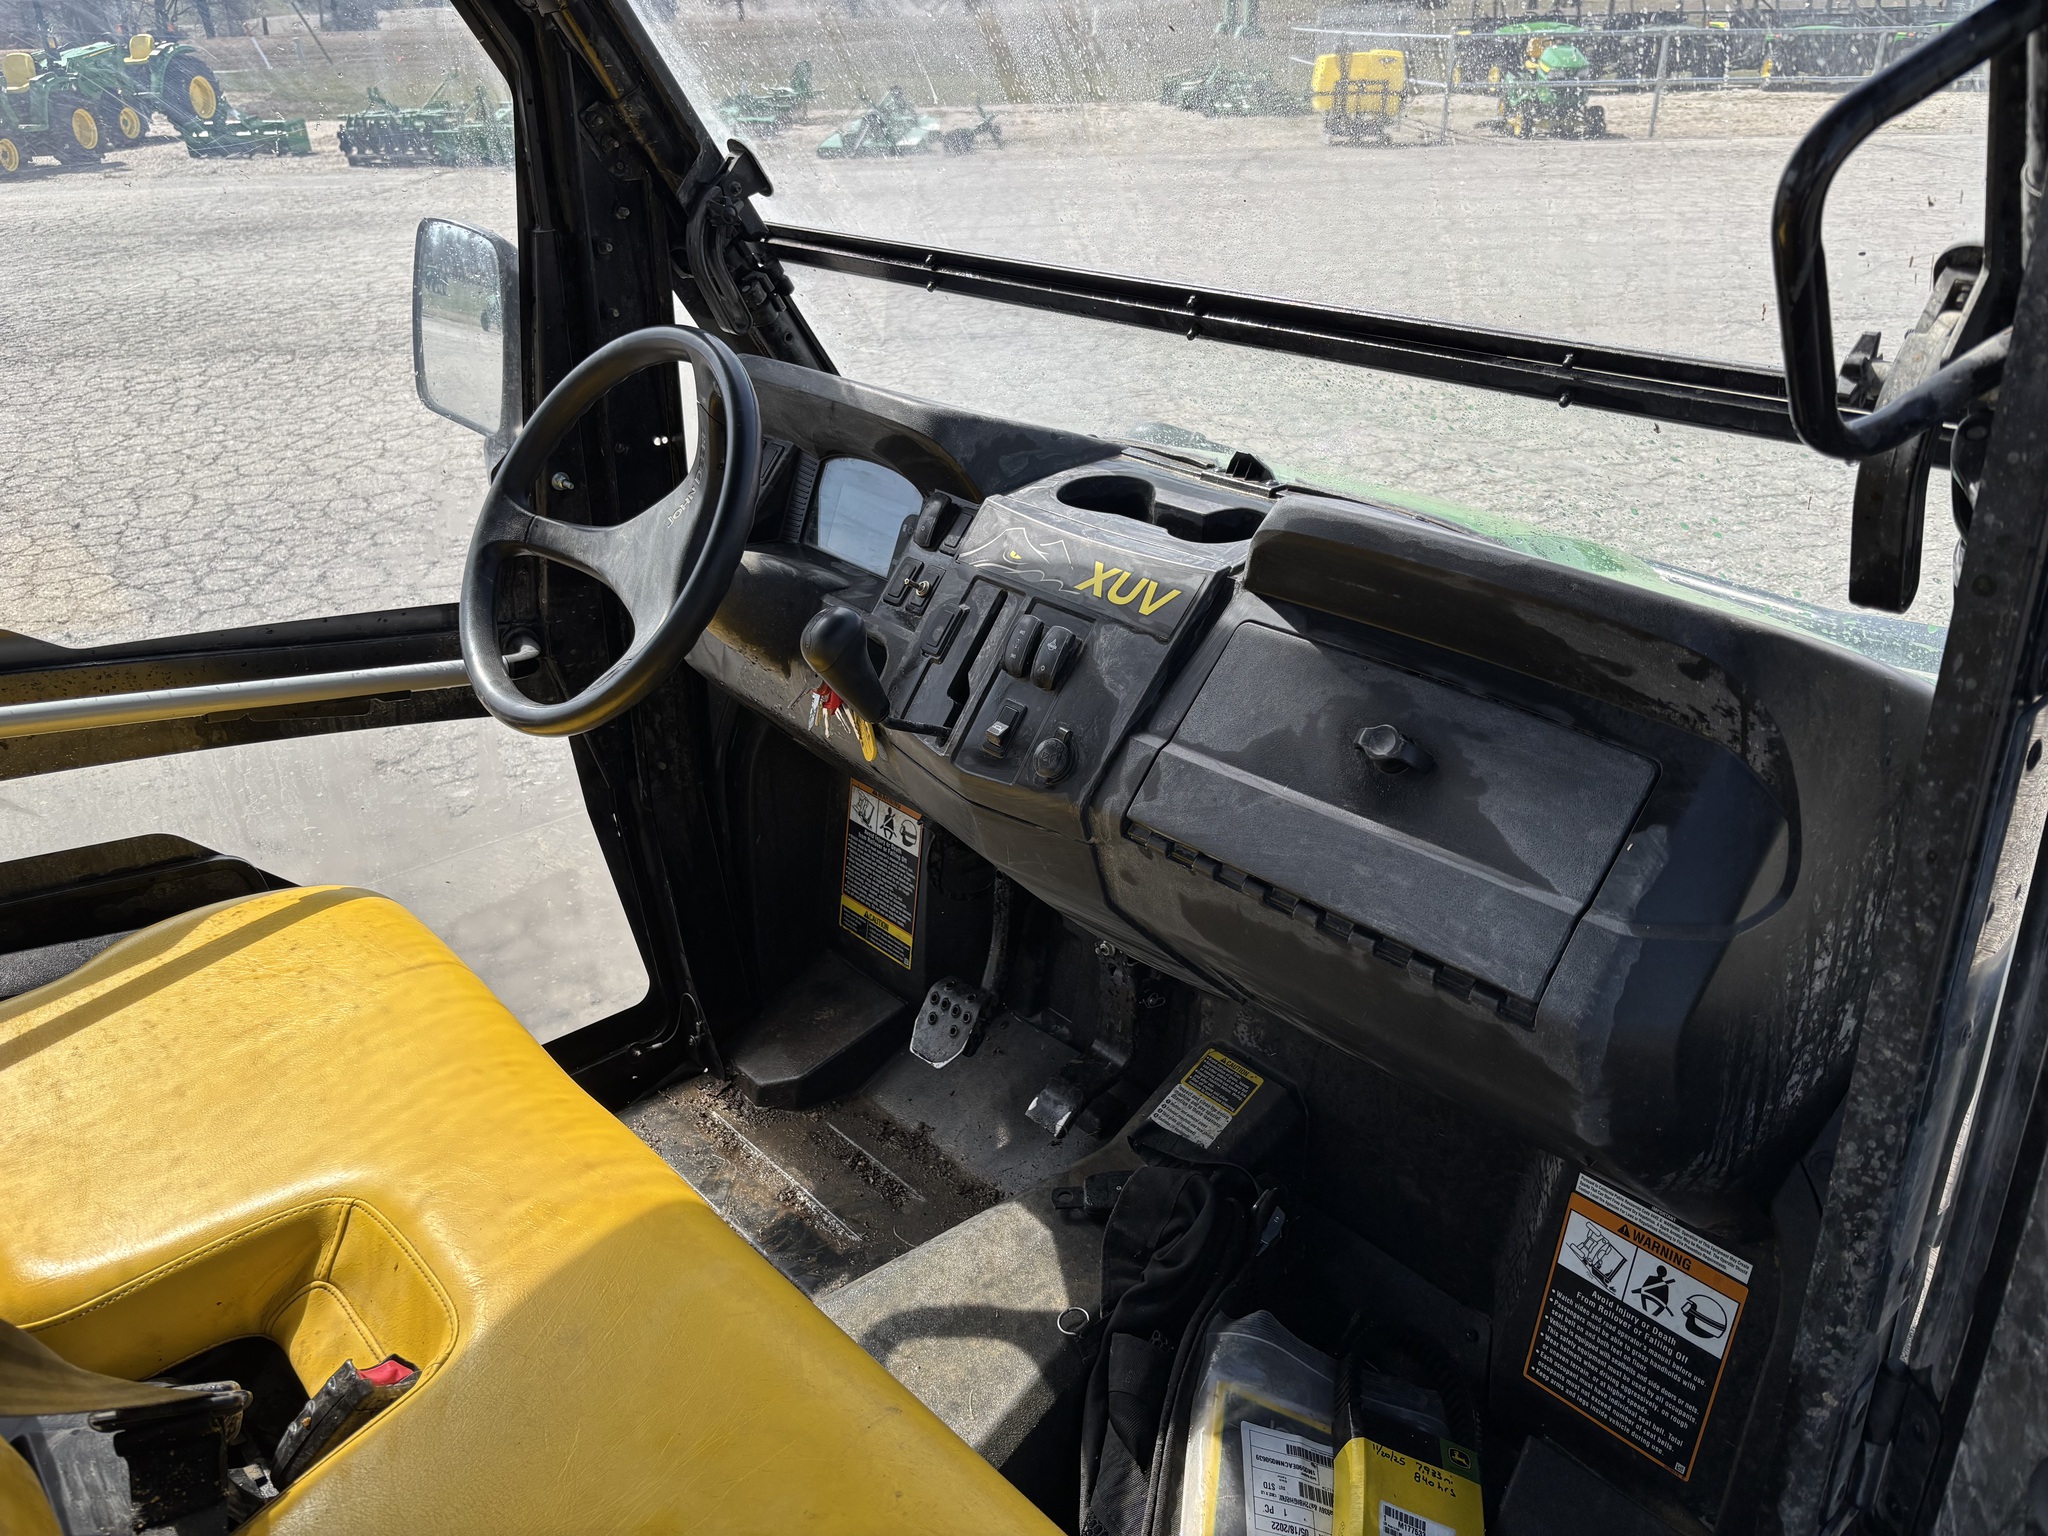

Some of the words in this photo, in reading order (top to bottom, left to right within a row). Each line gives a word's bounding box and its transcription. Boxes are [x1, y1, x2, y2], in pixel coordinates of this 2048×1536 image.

[667, 486, 697, 528] JOHN
[1075, 561, 1182, 617] XUV
[868, 912, 889, 931] CAUTION
[1225, 1059, 1249, 1077] CAUTION
[1631, 1229, 1692, 1271] WARNING
[1551, 1309, 1564, 1320] seat
[1564, 1316, 1576, 1328] belt
[1584, 1330, 1596, 1340] and
[1596, 1336, 1610, 1349] both
[1610, 1345, 1623, 1357] feet
[1631, 1358, 1648, 1373] floor.
[1553, 1299, 1586, 1324] Passengers
[1586, 1320, 1601, 1333] must
[1610, 1335, 1624, 1347] able
[1631, 1349, 1649, 1363] grasp
[1649, 1359, 1681, 1382] handholds
[1682, 1379, 1696, 1391] with
[1556, 1290, 1574, 1306] Watch
[1574, 1302, 1590, 1316] video
[1590, 1313, 1602, 1323] and
[1602, 1320, 1617, 1332] read
[1617, 1329, 1647, 1351] operator's
[1648, 1348, 1671, 1365] manual
[1671, 1361, 1692, 1378] before
[1693, 1375, 1707, 1387] use.
[1576, 1291, 1596, 1308] From
[1598, 1304, 1632, 1329] Rollover
[1633, 1327, 1642, 1336] or
[1644, 1332, 1673, 1356] Falling
[1675, 1351, 1688, 1364] Off
[1591, 1290, 1614, 1308] Avoid
[1615, 1304, 1640, 1325] Injury
[1641, 1321, 1650, 1330] or
[1652, 1326, 1676, 1346] Death
[1545, 1333, 1559, 1347] Wear
[1559, 1343, 1582, 1363] helmets
[1583, 1359, 1599, 1373] when
[1599, 1370, 1620, 1387] driving
[1620, 1383, 1659, 1412] aggressively,
[1670, 1414, 1689, 1429] rough
[1547, 1325, 1559, 1337] This
[1559, 1334, 1577, 1349] safety
[1577, 1346, 1607, 1368] equipment
[1607, 1365, 1622, 1378] must
[1631, 1380, 1646, 1393] used
[1655, 1394, 1664, 1404] all
[1664, 1401, 1697, 1424] occupants.
[1549, 1316, 1568, 1333] Vehicle
[1574, 1334, 1599, 1353] equipped
[1599, 1349, 1611, 1360] with
[1611, 1357, 1636, 1376] seatbelts
[1636, 1372, 1648, 1383] and
[1647, 1379, 1661, 1391] side
[1660, 1387, 1677, 1401] doors
[1684, 1402, 1699, 1415] nets.
[1549, 1348, 1569, 1364] uneven
[1569, 1360, 1591, 1379] terrain,
[1606, 1384, 1626, 1400] higher
[1626, 1397, 1649, 1416] speeds.
[1535, 1367, 1550, 1381] Keep
[1550, 1378, 1564, 1391] arms
[1565, 1388, 1576, 1398] and
[1576, 1394, 1589, 1407] legs
[1589, 1403, 1608, 1419] inside
[1609, 1416, 1630, 1434] vehicle
[1630, 1431, 1651, 1448] during
[1651, 1444, 1664, 1456] use.
[1537, 1360, 1565, 1382] occupants
[1565, 1378, 1580, 1391] must
[1580, 1388, 1591, 1398] not
[1591, 1395, 1612, 1412] exceed
[1612, 1409, 1635, 1426] number
[1642, 1428, 1657, 1441] seat
[1656, 1436, 1674, 1452] belts.
[1539, 1351, 1553, 1364] Each
[1553, 1361, 1579, 1380] occupant
[1578, 1377, 1593, 1390] must
[1593, 1386, 1608, 1399] have
[1608, 1395, 1638, 1418] individual
[1638, 1415, 1652, 1427] seat
[1652, 1423, 1666, 1437] belt.
[1668, 1432, 1683, 1447] Total
[1263, 1481, 1275, 1490] STD
[1263, 1504, 1274, 1514] PC
[1413, 1472, 1435, 1487] 840
[1437, 1480, 1457, 1497] hrs
[1271, 1521, 1308, 1536] 05/18/2022
